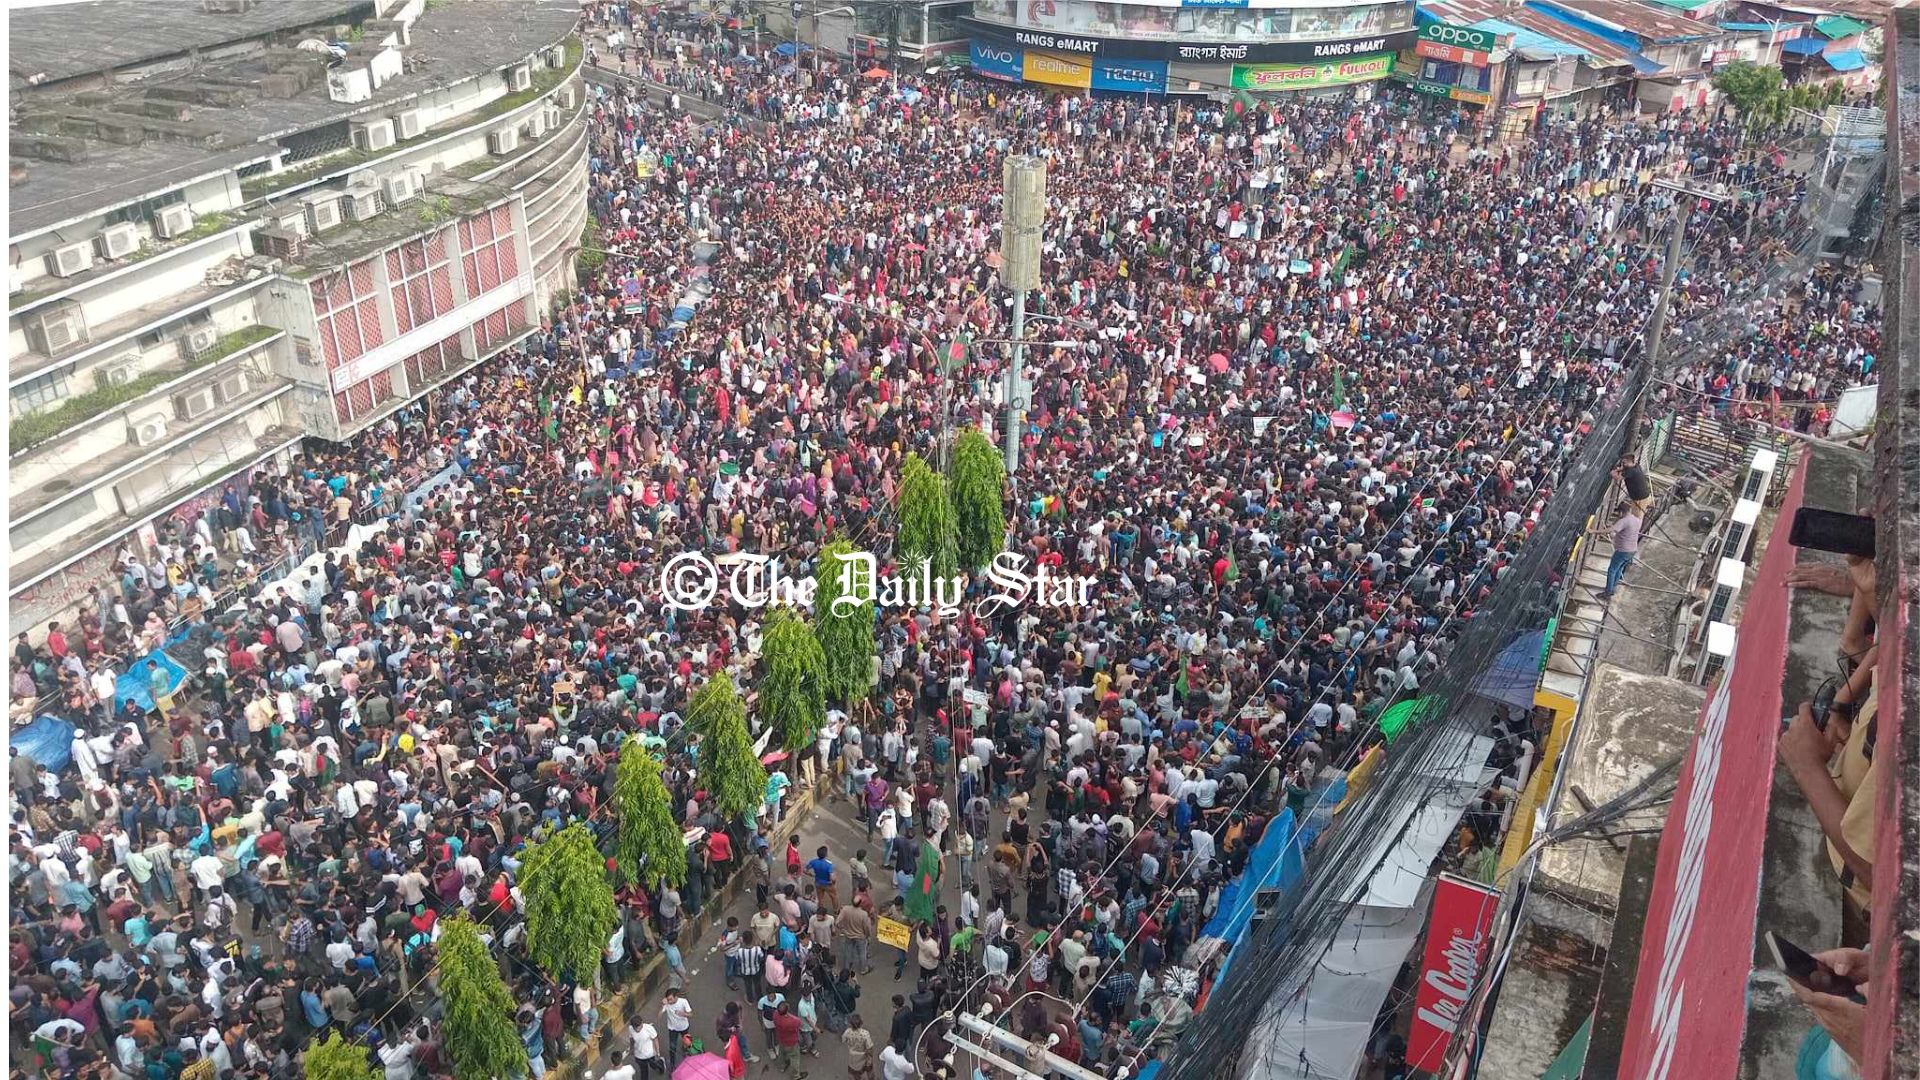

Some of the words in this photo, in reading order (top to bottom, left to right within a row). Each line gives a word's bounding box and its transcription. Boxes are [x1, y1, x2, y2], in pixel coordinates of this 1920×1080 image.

[1016, 32, 1054, 48] RANGS
[1057, 35, 1099, 52] eMART
[1314, 45, 1351, 56] RANGS
[1353, 39, 1386, 53] eMART
[977, 45, 1012, 63] vivo
[1220, 45, 1248, 60] ইমার্ট
[1032, 56, 1081, 75] realme
[1103, 67, 1154, 82] TECNO
[1254, 66, 1316, 84] ফুলকলি
[1425, 930, 1482, 1001] Cooper
